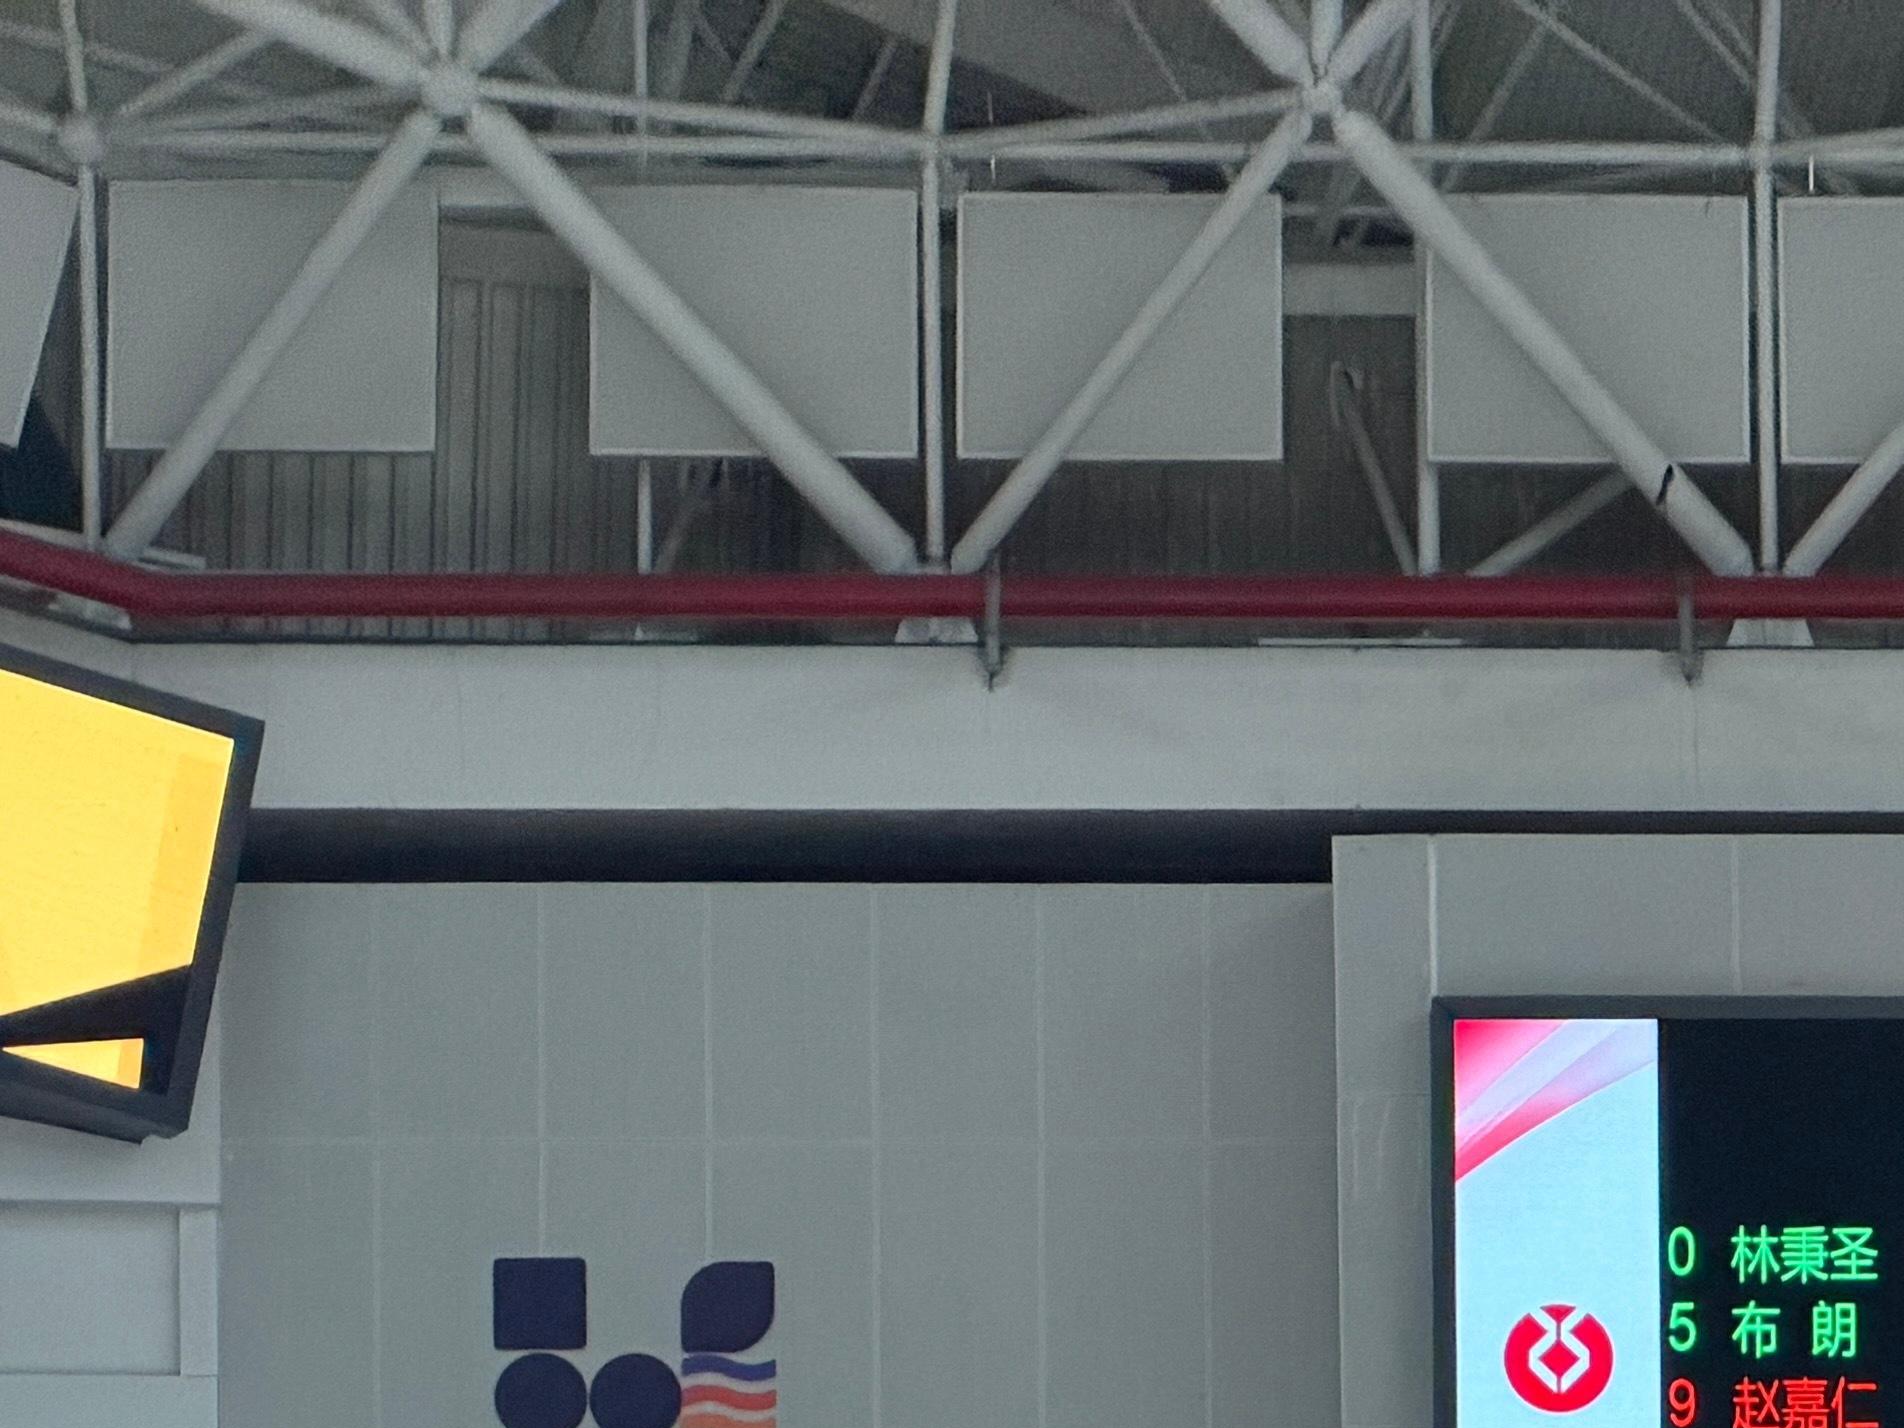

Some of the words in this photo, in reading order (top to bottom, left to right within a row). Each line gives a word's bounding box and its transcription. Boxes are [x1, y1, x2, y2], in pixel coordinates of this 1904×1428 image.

[1668, 1226, 1695, 1276] 0
[1731, 1225, 1878, 1284] 林秉圣
[1669, 1302, 1696, 1352] 5
[1669, 1379, 1695, 1427] 9
